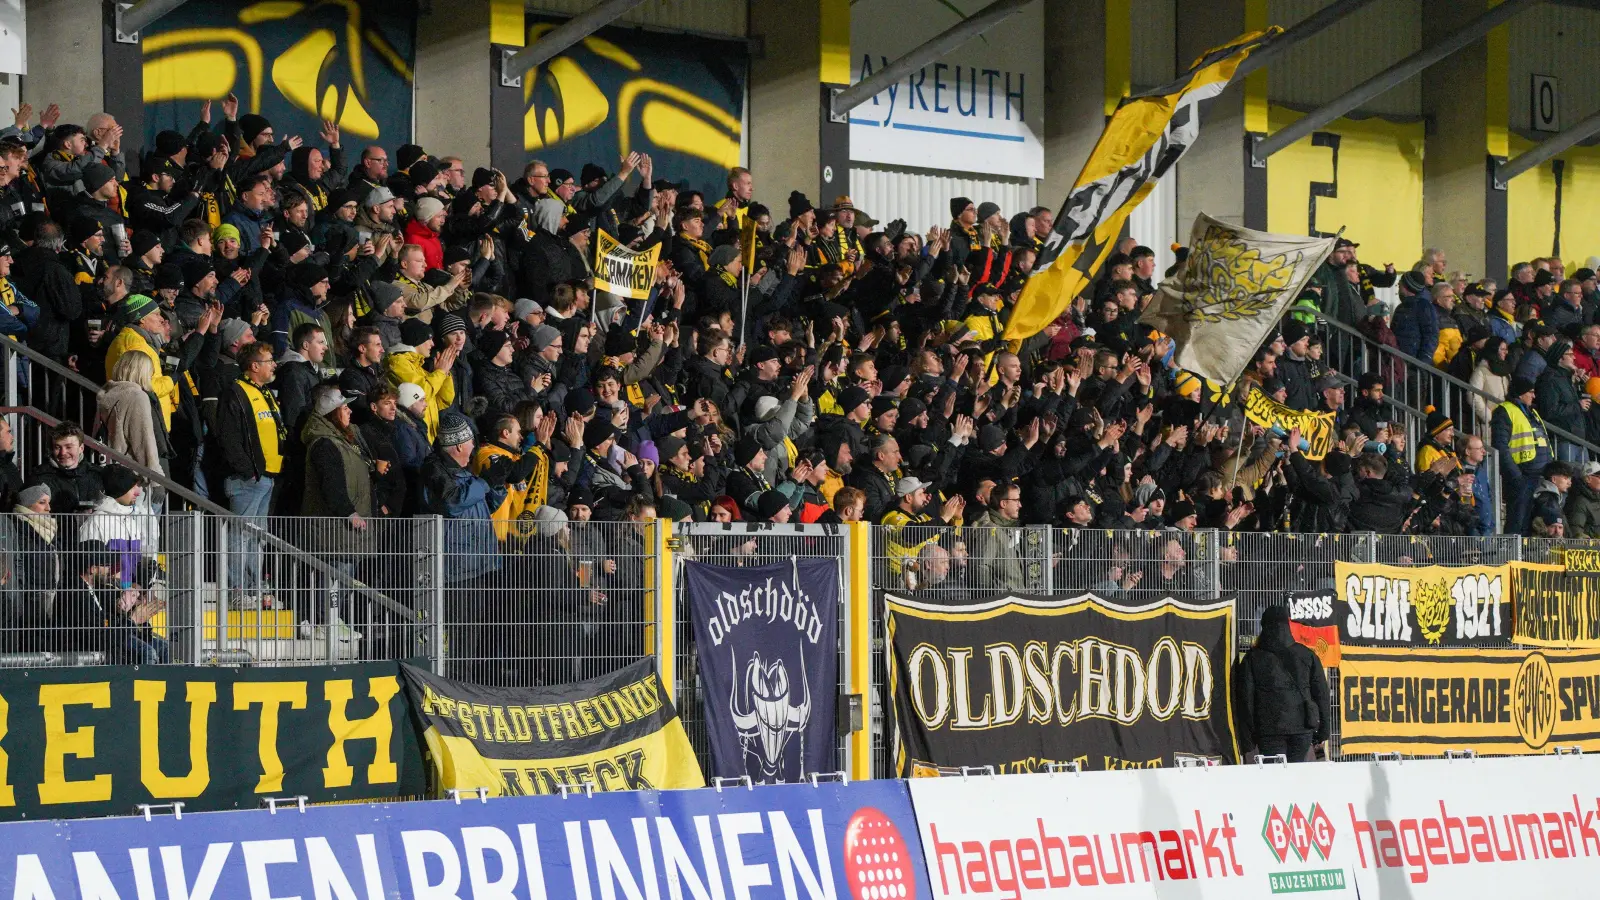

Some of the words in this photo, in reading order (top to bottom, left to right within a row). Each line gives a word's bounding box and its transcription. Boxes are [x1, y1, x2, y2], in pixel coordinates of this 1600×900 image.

[1346, 573, 1413, 642] SZENE
[1451, 573, 1503, 640] 1921
[1343, 675, 1511, 724] GEGENGERADE
[0, 675, 401, 808] EUTH
[929, 809, 1244, 900] hagebaumarkt
[1270, 815, 1331, 849] BHG
[1347, 793, 1600, 884] hagebaumark
[1270, 872, 1344, 890] BAUZENTRUM
